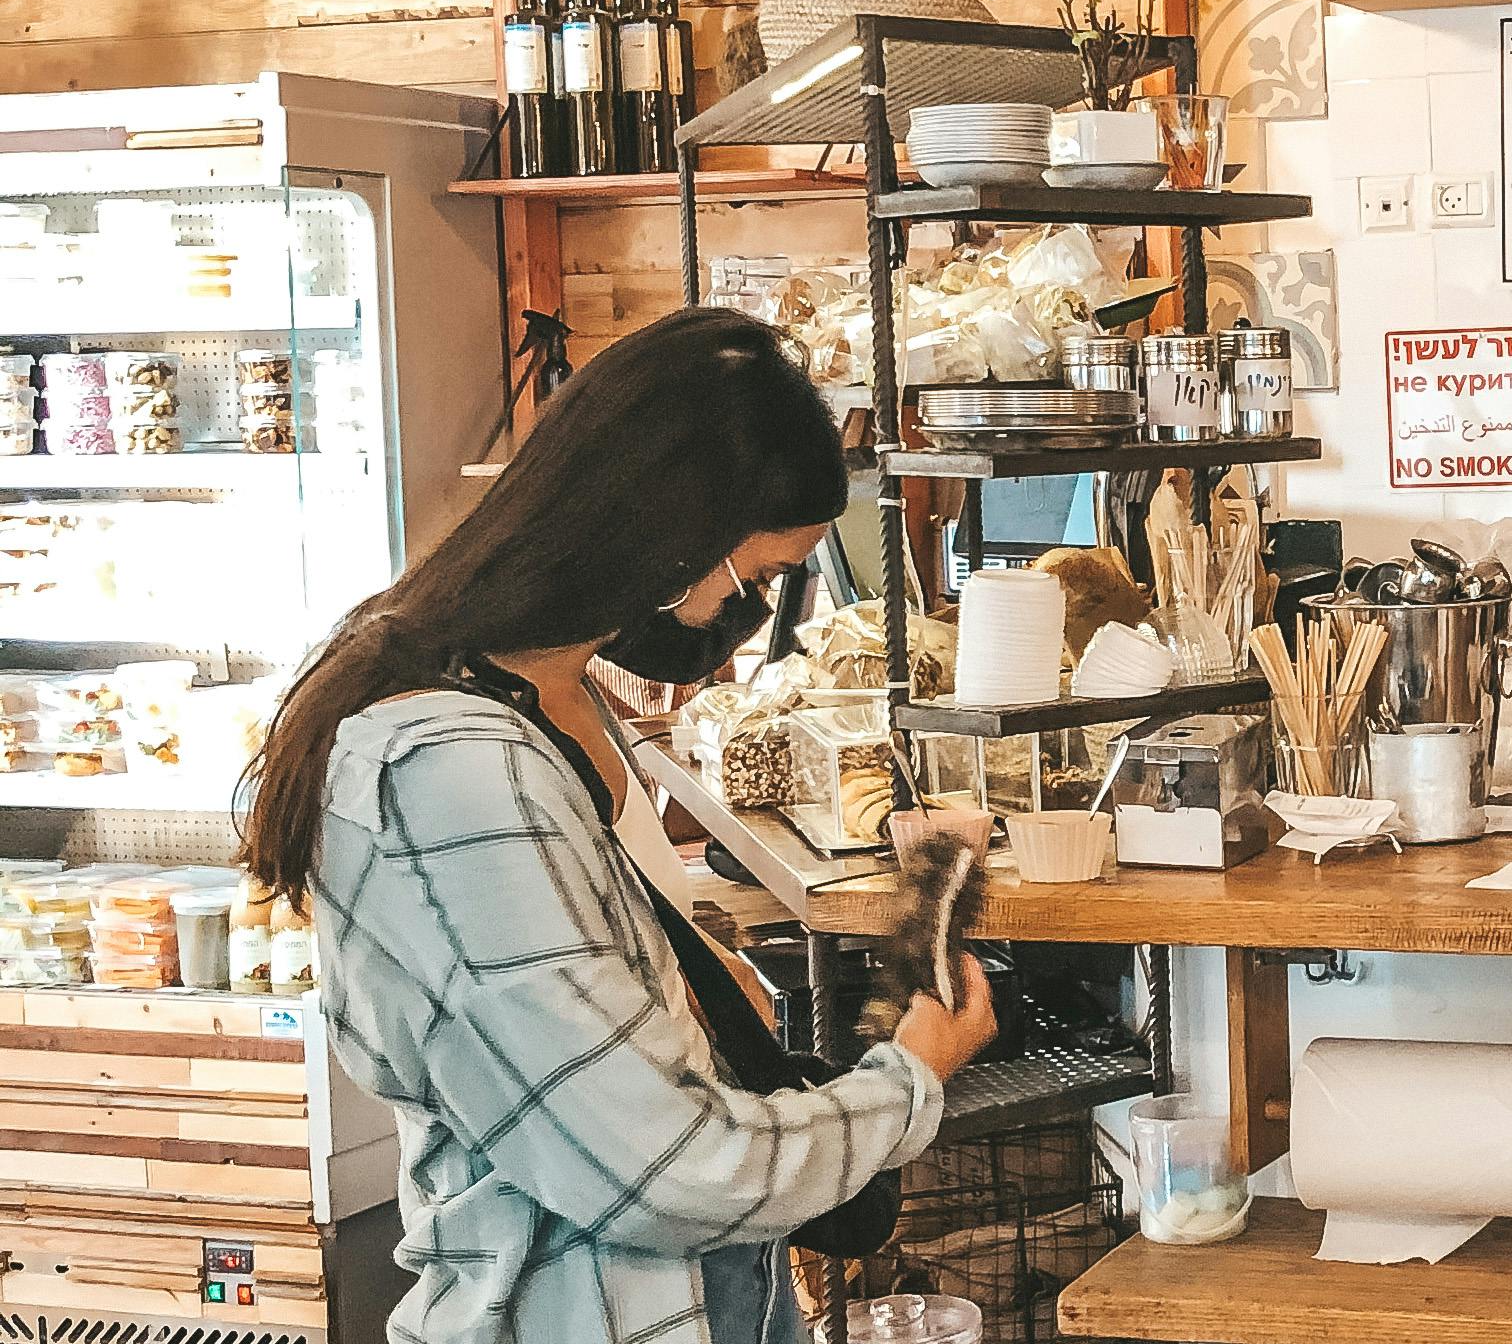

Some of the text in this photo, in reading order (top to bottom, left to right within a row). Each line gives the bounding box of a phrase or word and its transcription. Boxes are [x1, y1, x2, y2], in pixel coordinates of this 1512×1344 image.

[1393, 335, 1478, 364] לעשן!
[1398, 415, 1512, 442] ممنوع التدخين
[1396, 458, 1432, 478] NO
